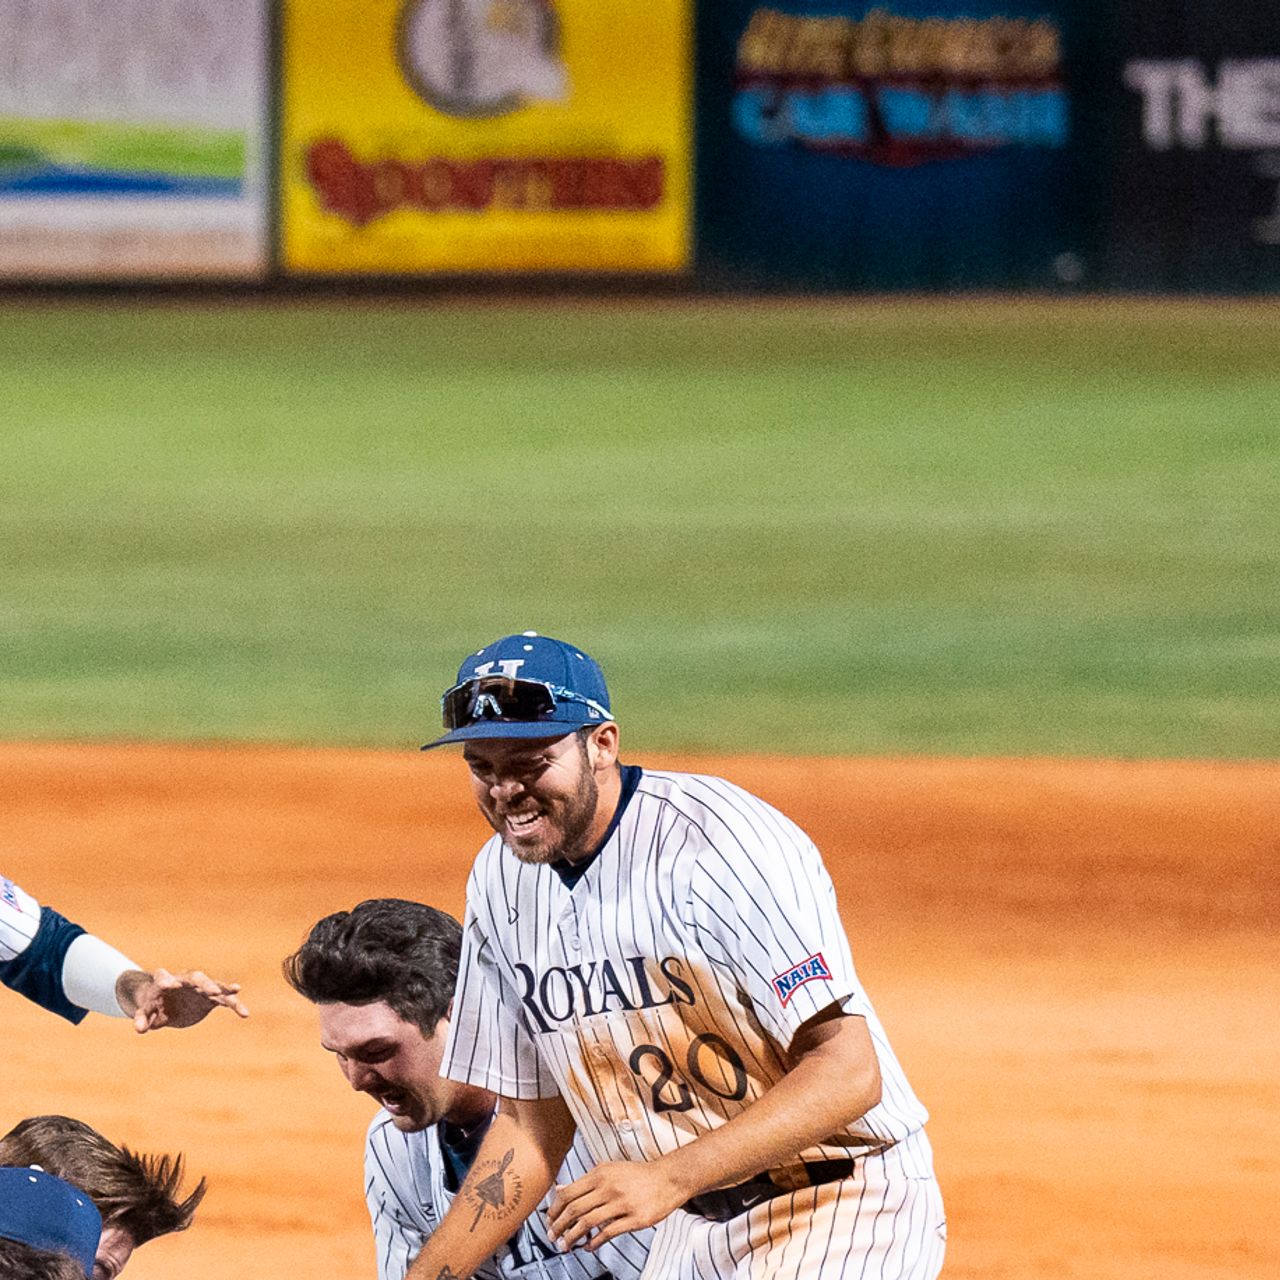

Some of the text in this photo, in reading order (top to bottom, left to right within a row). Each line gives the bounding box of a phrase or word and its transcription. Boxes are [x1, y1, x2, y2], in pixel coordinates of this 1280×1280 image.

[515, 955, 695, 1035] ROYALS
[775, 957, 829, 1002] NAIA
[628, 1031, 748, 1114] 20
